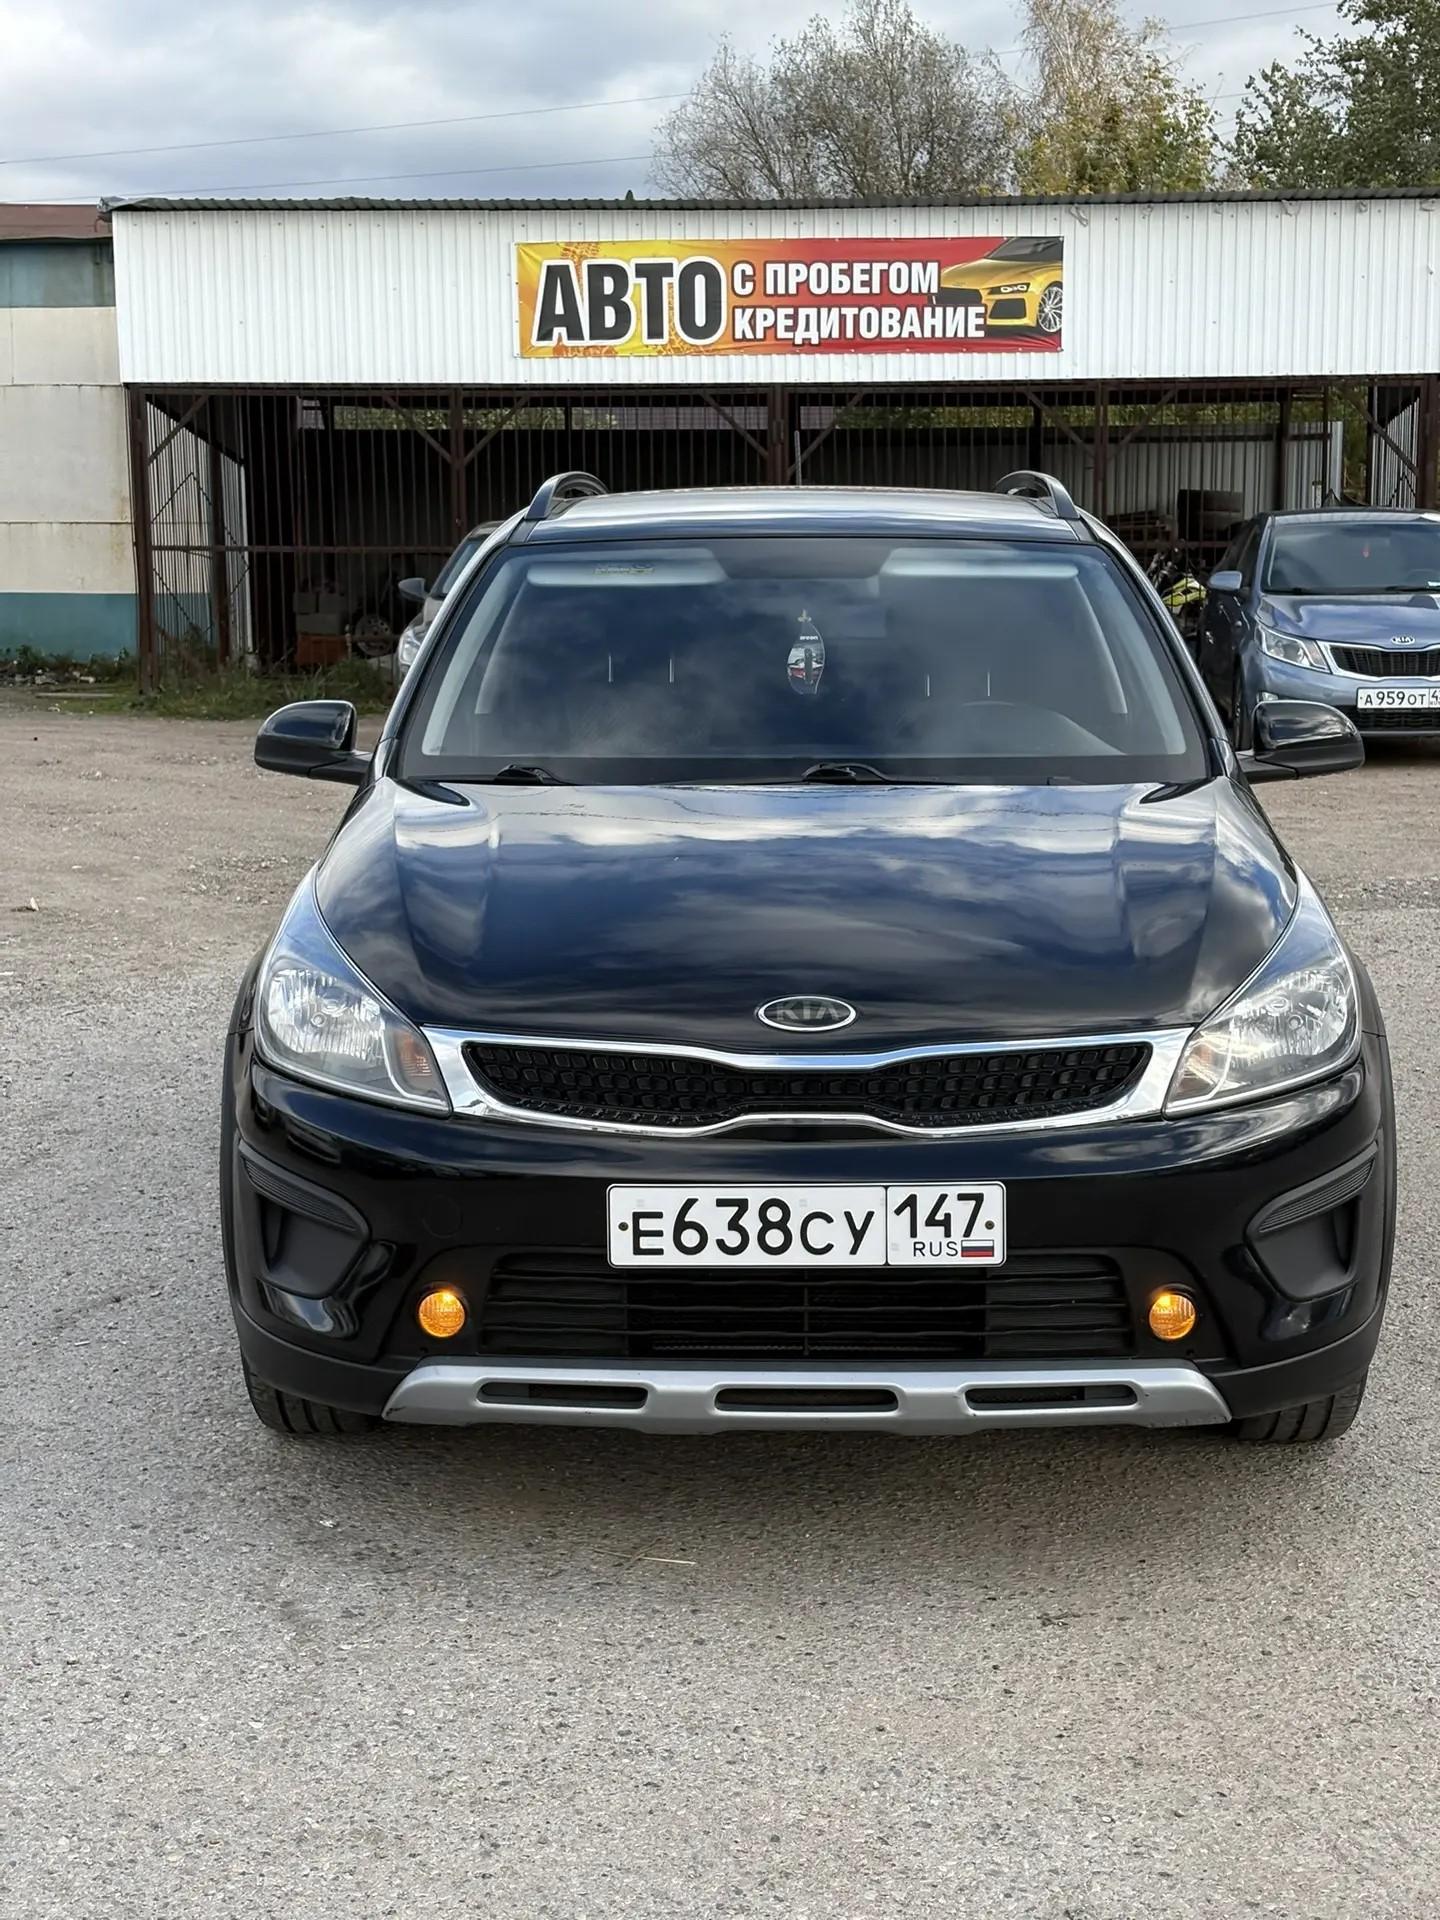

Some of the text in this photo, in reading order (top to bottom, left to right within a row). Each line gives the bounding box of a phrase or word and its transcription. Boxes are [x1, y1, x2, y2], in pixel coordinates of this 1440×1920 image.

[733, 262, 939, 295] С ПРОБЕГОМ
[534, 257, 725, 344] АВТО
[733, 305, 985, 345] КРЕДИТОВАНИЕ
[1364, 691, 1427, 706] А959ОТ
[1431, 690, 1440, 702] 4
[776, 1000, 841, 1020] KIA
[631, 1197, 875, 1255] Е638СУ
[893, 1193, 984, 1238] 147
[912, 1240, 958, 1257] RUS
